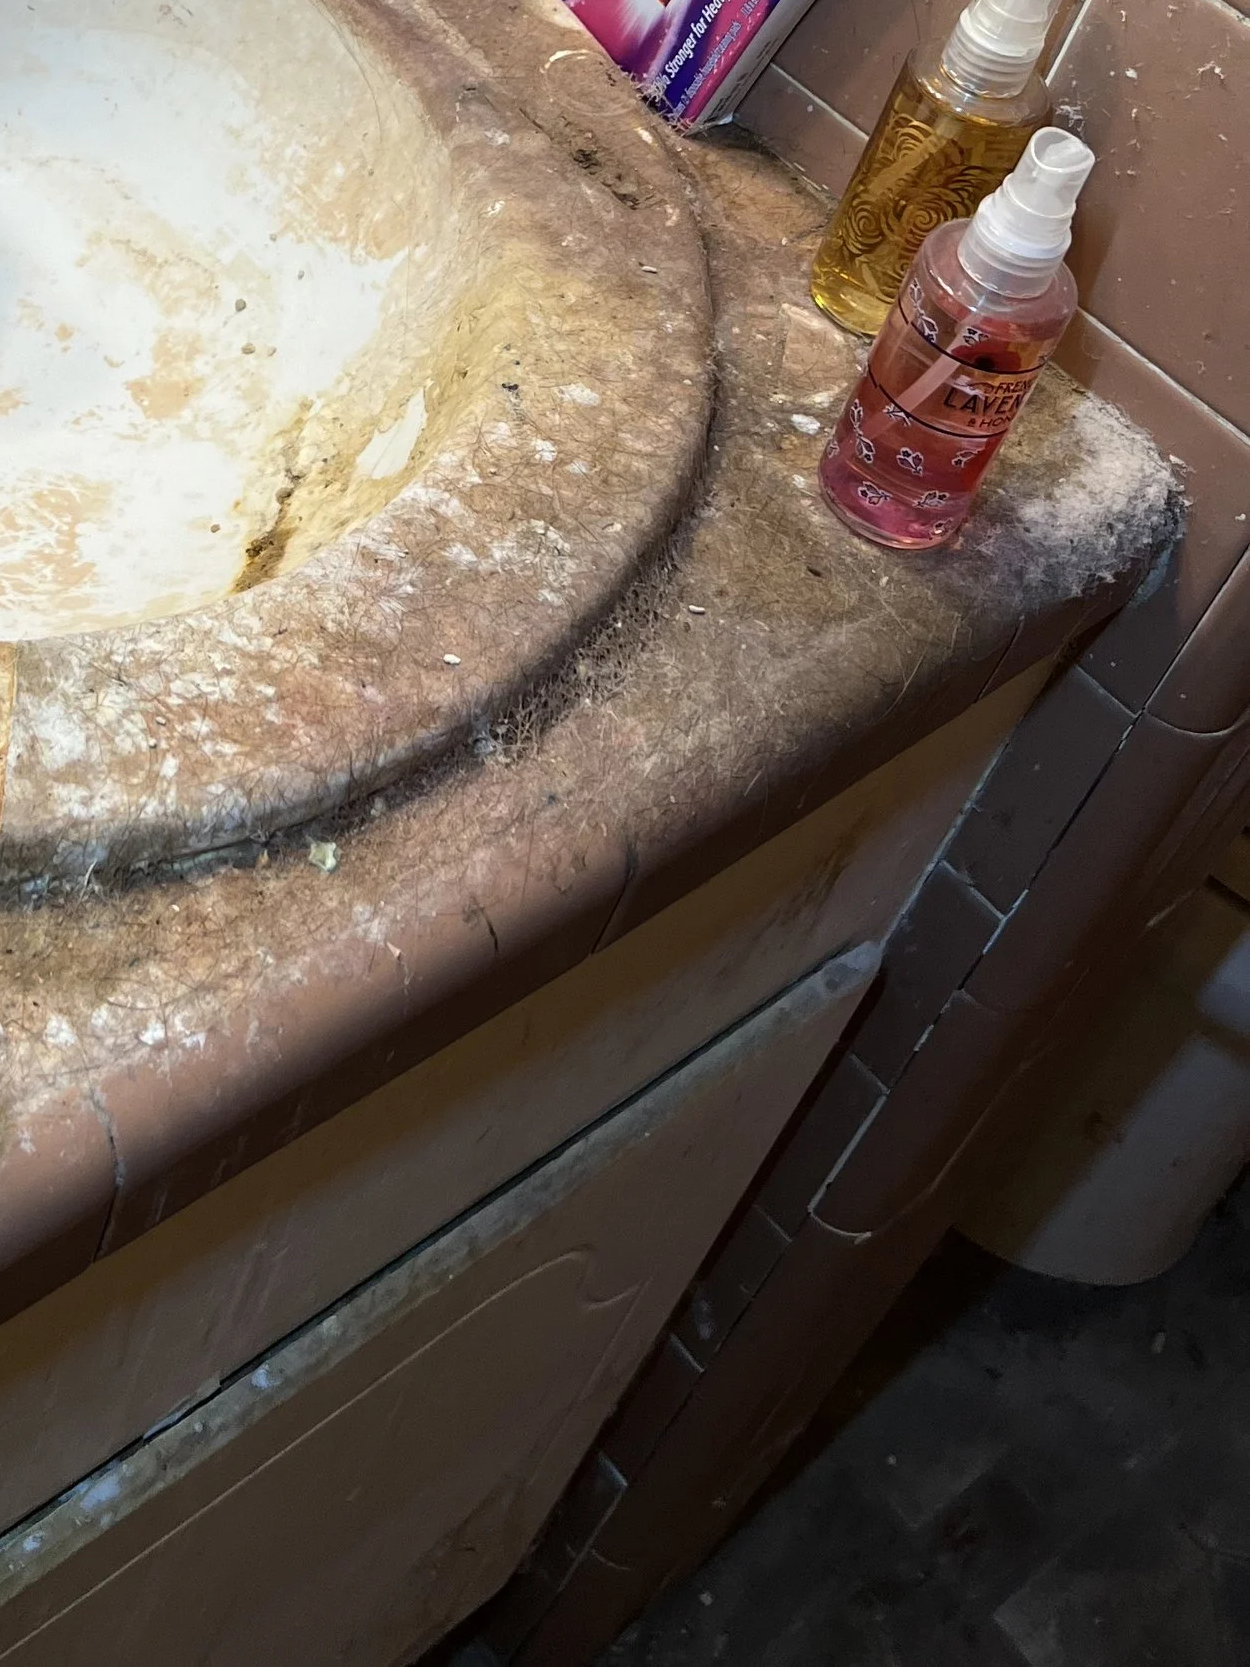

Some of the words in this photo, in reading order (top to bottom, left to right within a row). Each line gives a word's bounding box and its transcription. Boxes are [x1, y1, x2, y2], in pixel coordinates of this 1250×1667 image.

[664, 35, 701, 78] Stronger
[690, 15, 708, 40] for
[995, 379, 1032, 394] FREN
[943, 387, 1025, 415] LAVEN
[979, 415, 1012, 428] HON
